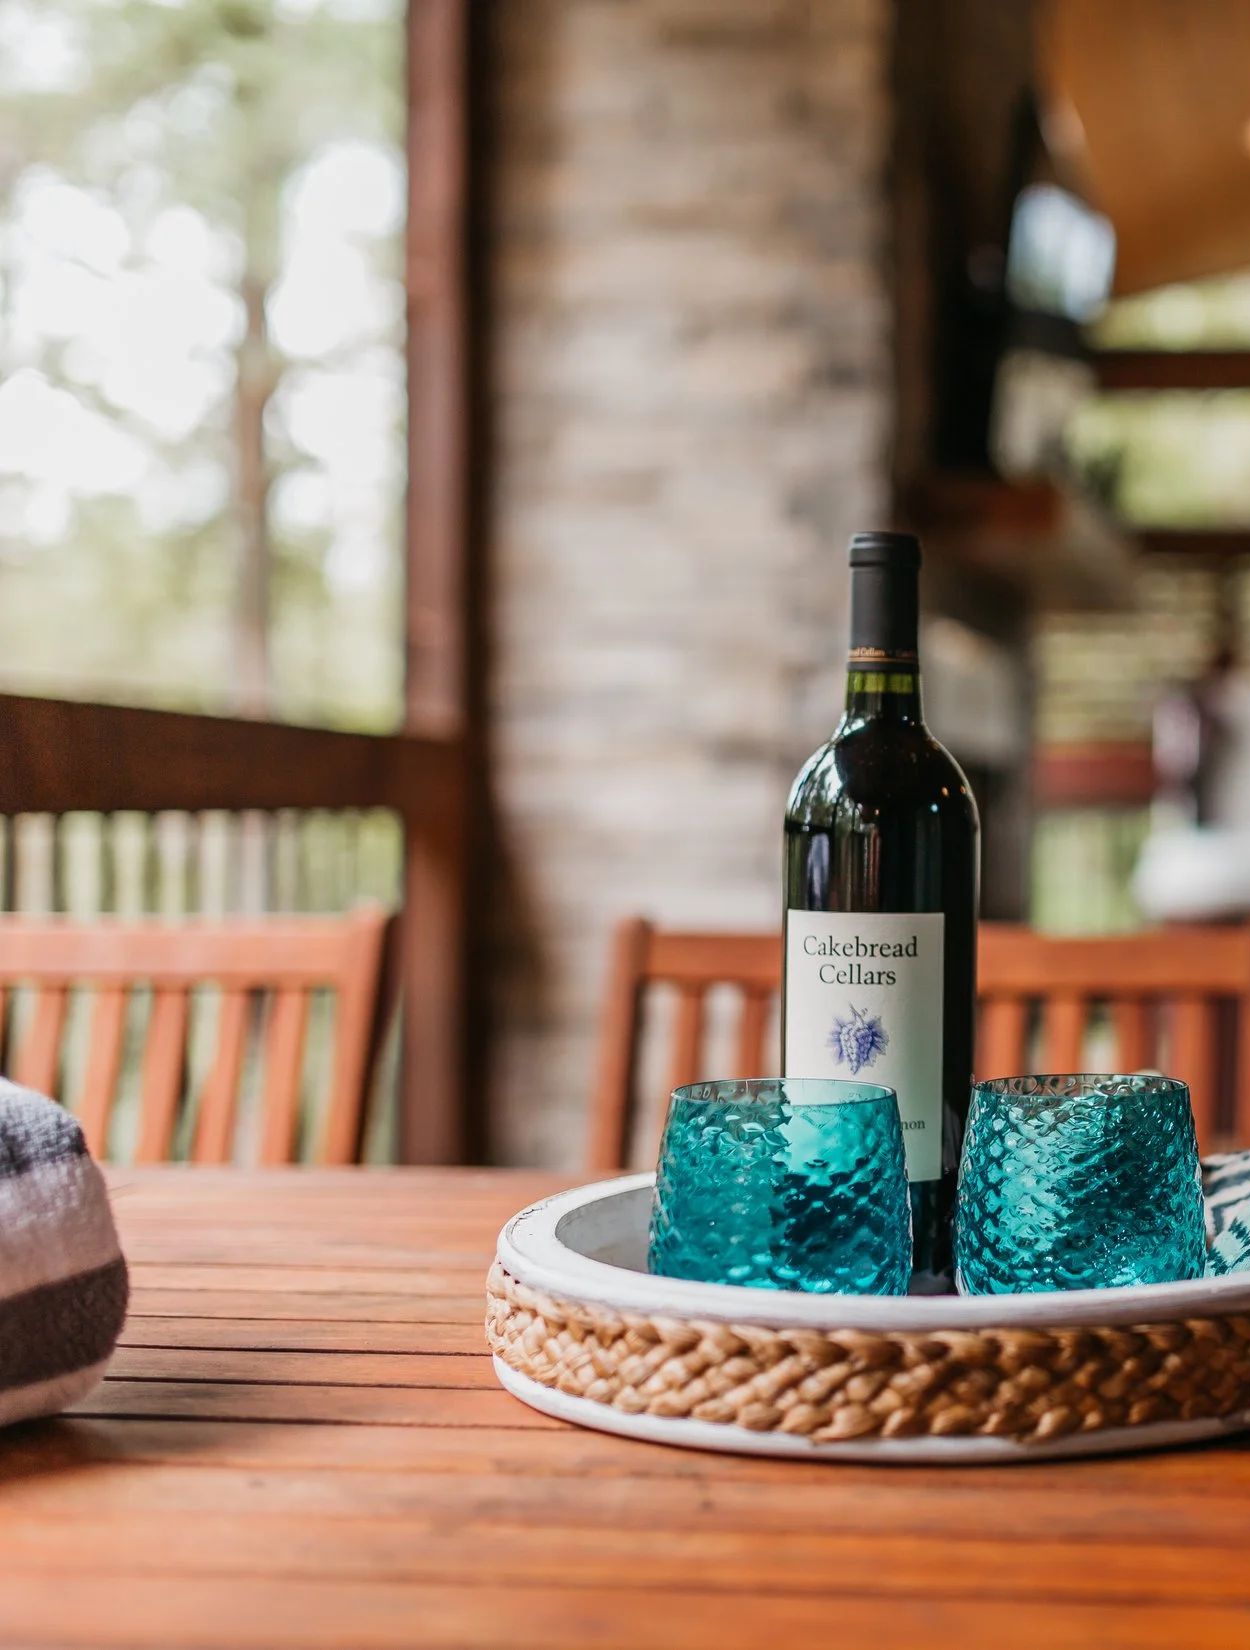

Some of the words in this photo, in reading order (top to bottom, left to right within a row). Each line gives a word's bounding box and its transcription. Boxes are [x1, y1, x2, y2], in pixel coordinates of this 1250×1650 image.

[803, 934, 919, 958] Cakebread
[819, 963, 897, 986] Cellars
[901, 1115, 926, 1130] non
